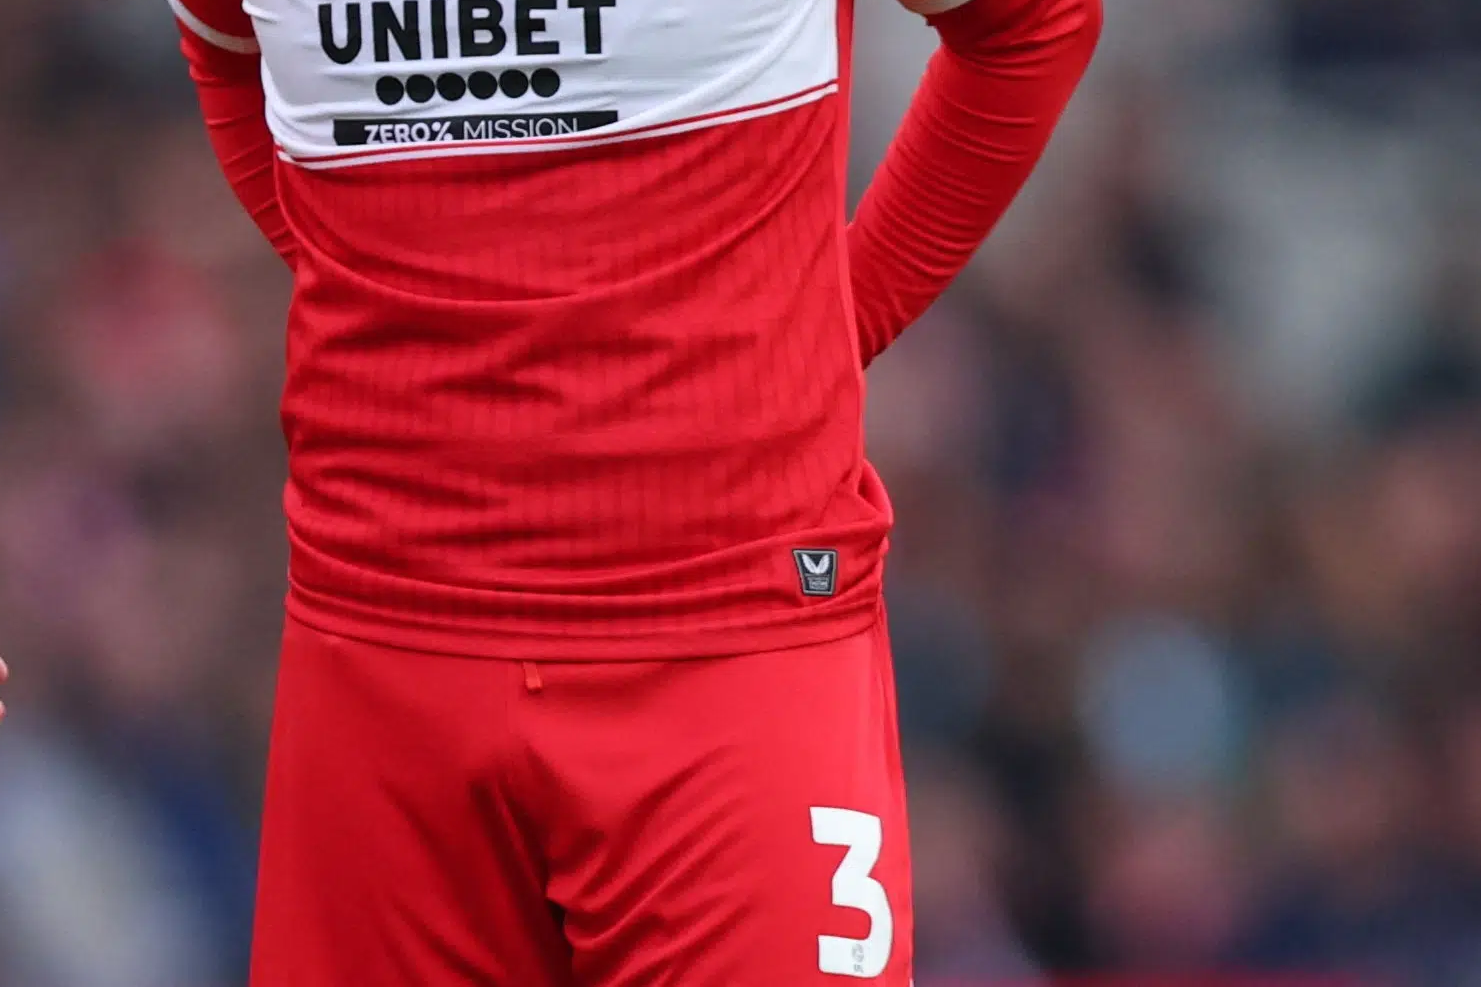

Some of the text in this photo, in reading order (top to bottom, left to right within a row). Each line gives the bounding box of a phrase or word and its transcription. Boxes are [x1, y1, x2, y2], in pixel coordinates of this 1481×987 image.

[364, 117, 577, 144] ZERO% MISSION
[809, 806, 894, 978] 3
